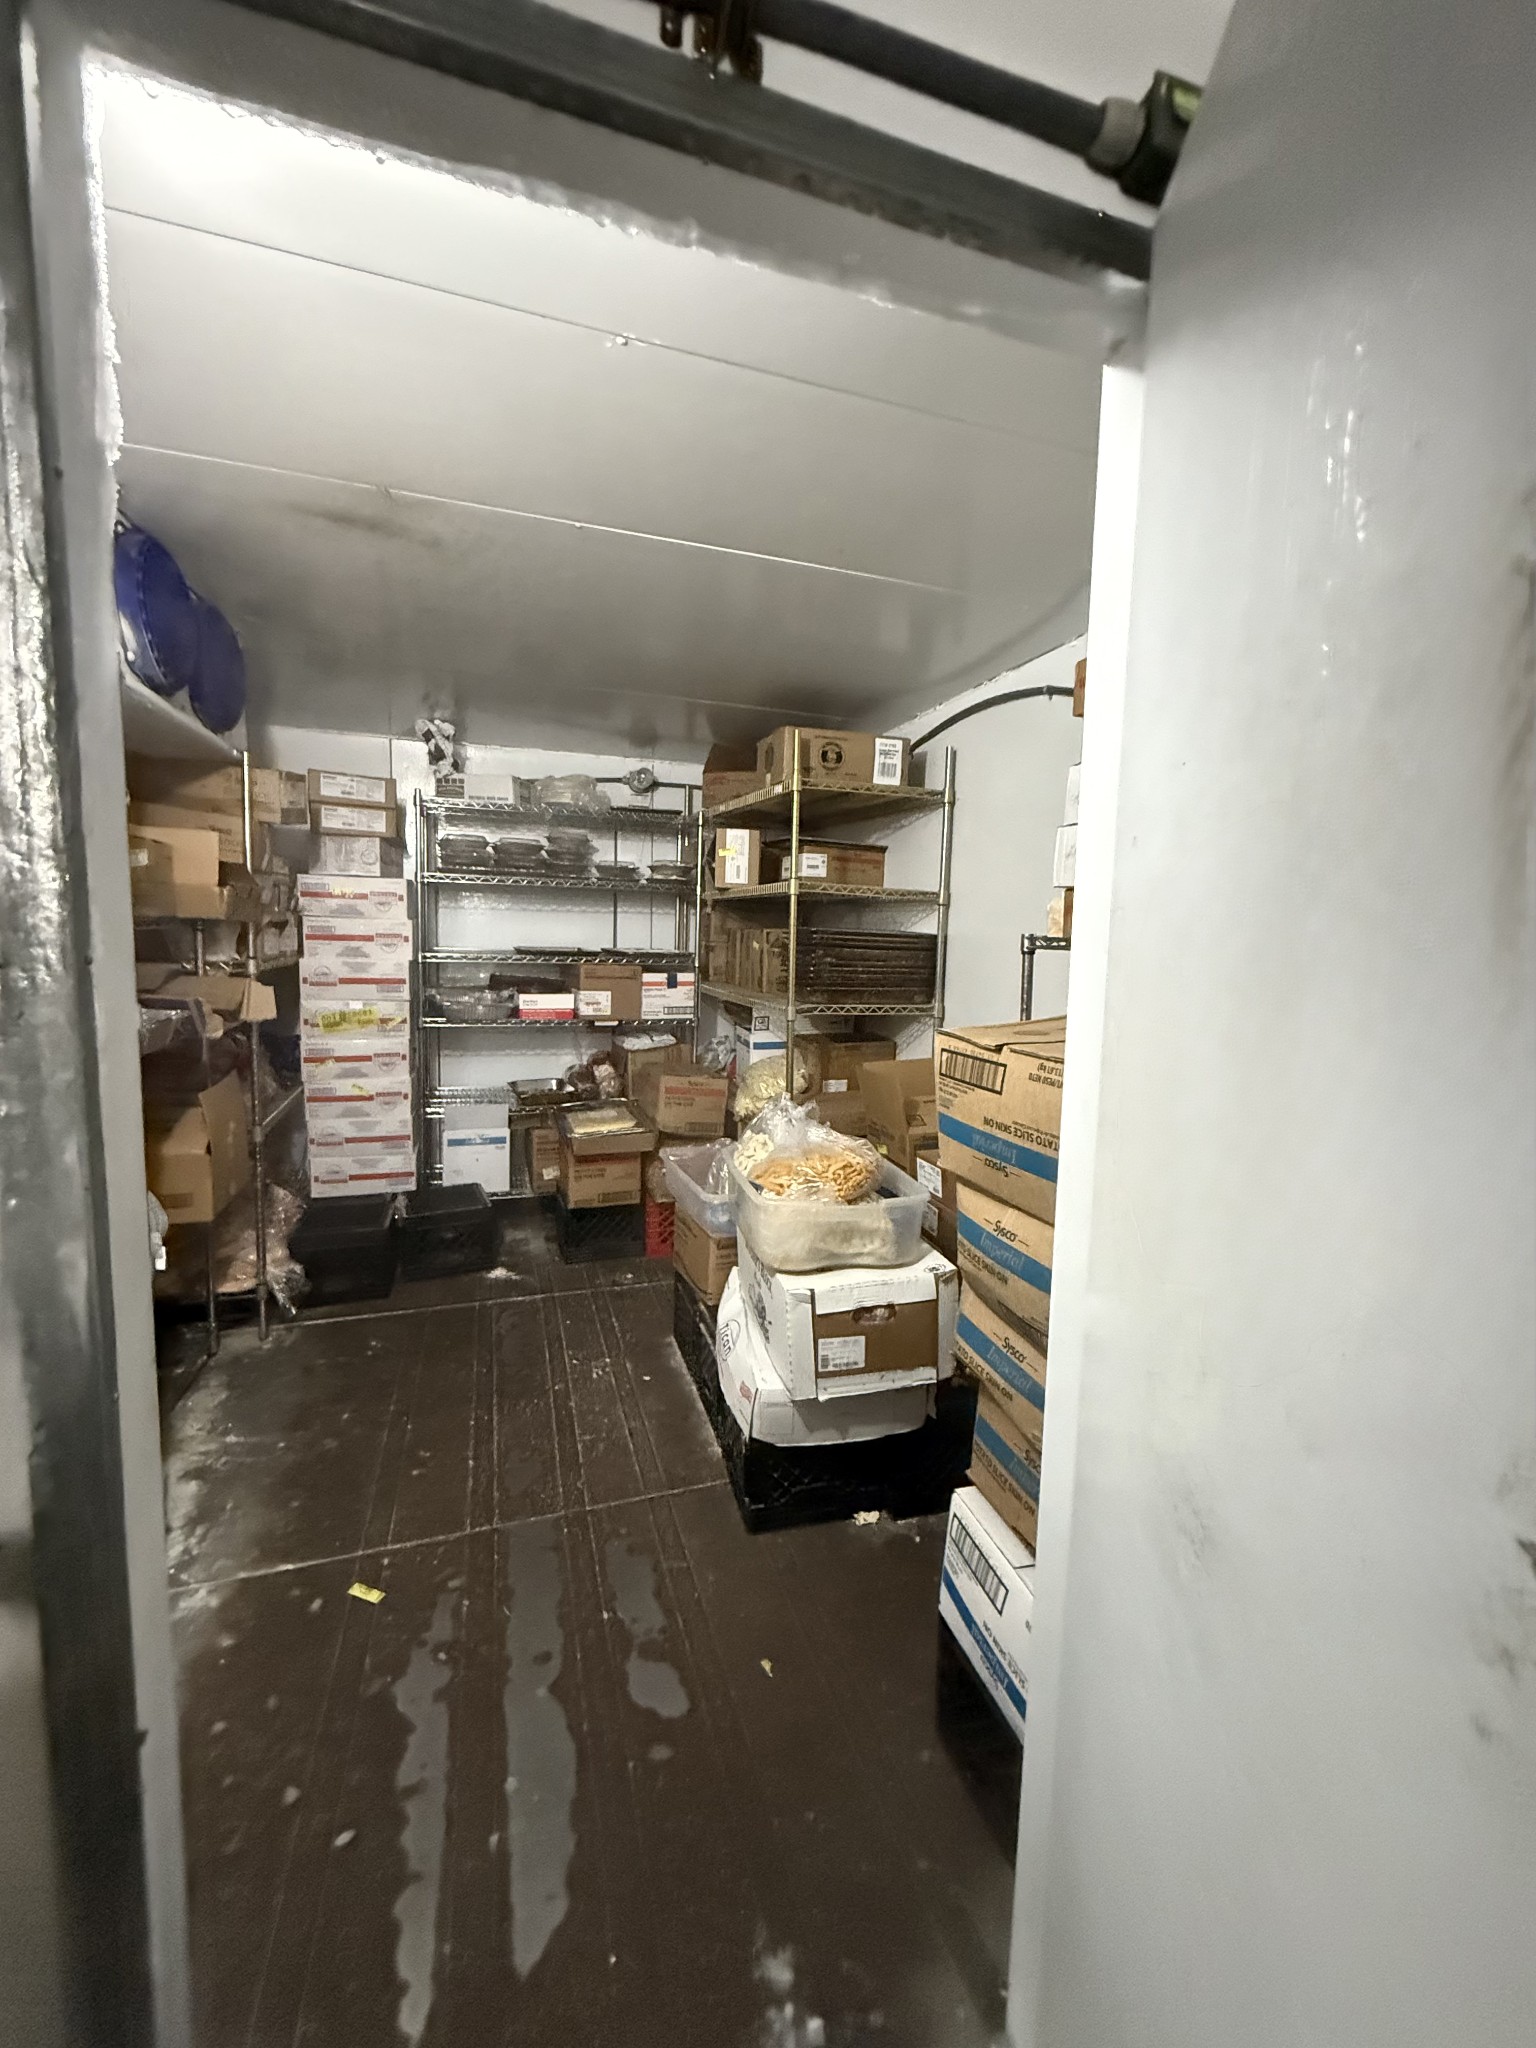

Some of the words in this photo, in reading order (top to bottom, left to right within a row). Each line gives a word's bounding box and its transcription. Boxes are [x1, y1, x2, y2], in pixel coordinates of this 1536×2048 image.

[983, 1116, 995, 1128] ON
[995, 1121, 1013, 1135] SKIN
[1013, 1126, 1034, 1143] SLICE
[984, 1157, 1009, 1178] Sysco
[993, 1219, 1018, 1243] Sysco
[980, 1231, 1025, 1271] Imperial
[720, 1322, 732, 1357] Tican
[1001, 1337, 1027, 1364] Sysco
[987, 1345, 1033, 1394] Imperial
[1001, 1387, 1014, 1402] ON
[1023, 1500, 1036, 1518] ON
